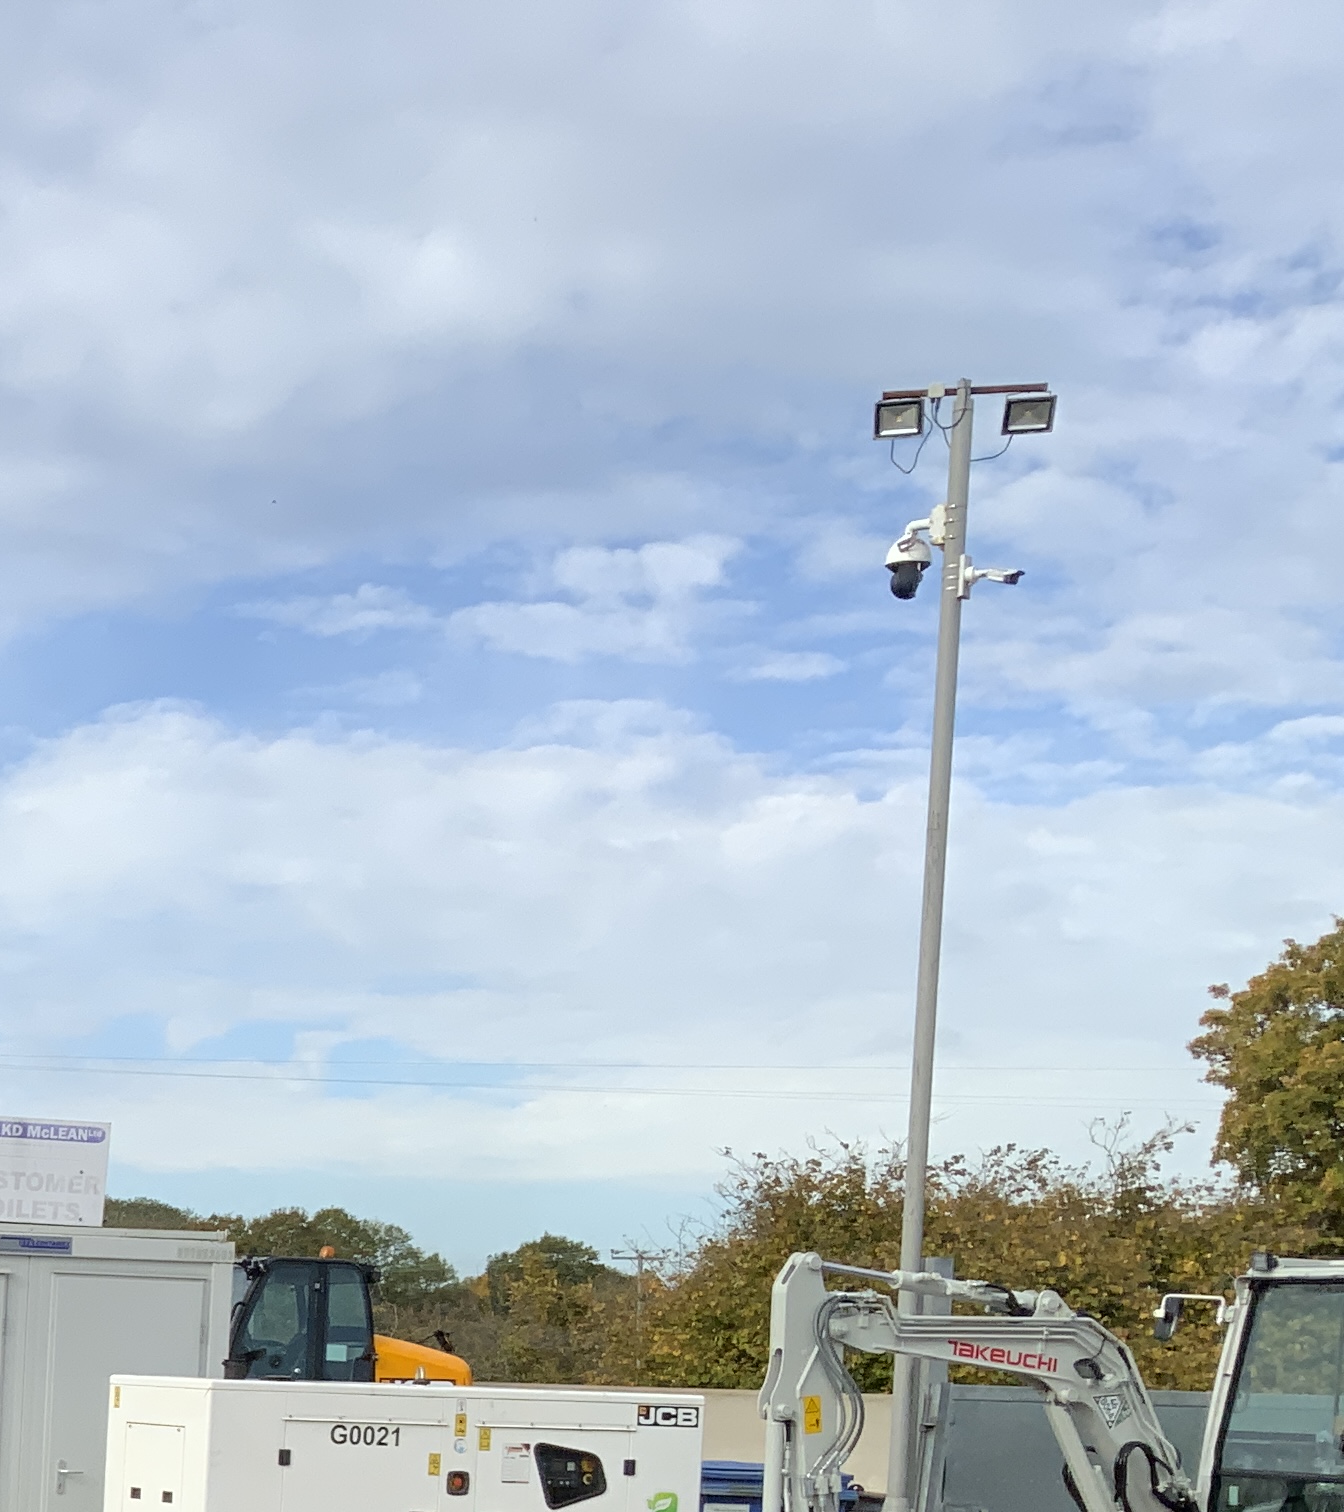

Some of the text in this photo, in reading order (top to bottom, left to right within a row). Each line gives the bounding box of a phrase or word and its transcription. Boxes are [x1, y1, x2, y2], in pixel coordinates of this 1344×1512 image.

[1, 1124, 23, 1137] KD
[638, 1406, 698, 1427] JCB
[330, 1424, 401, 1448] G0021
